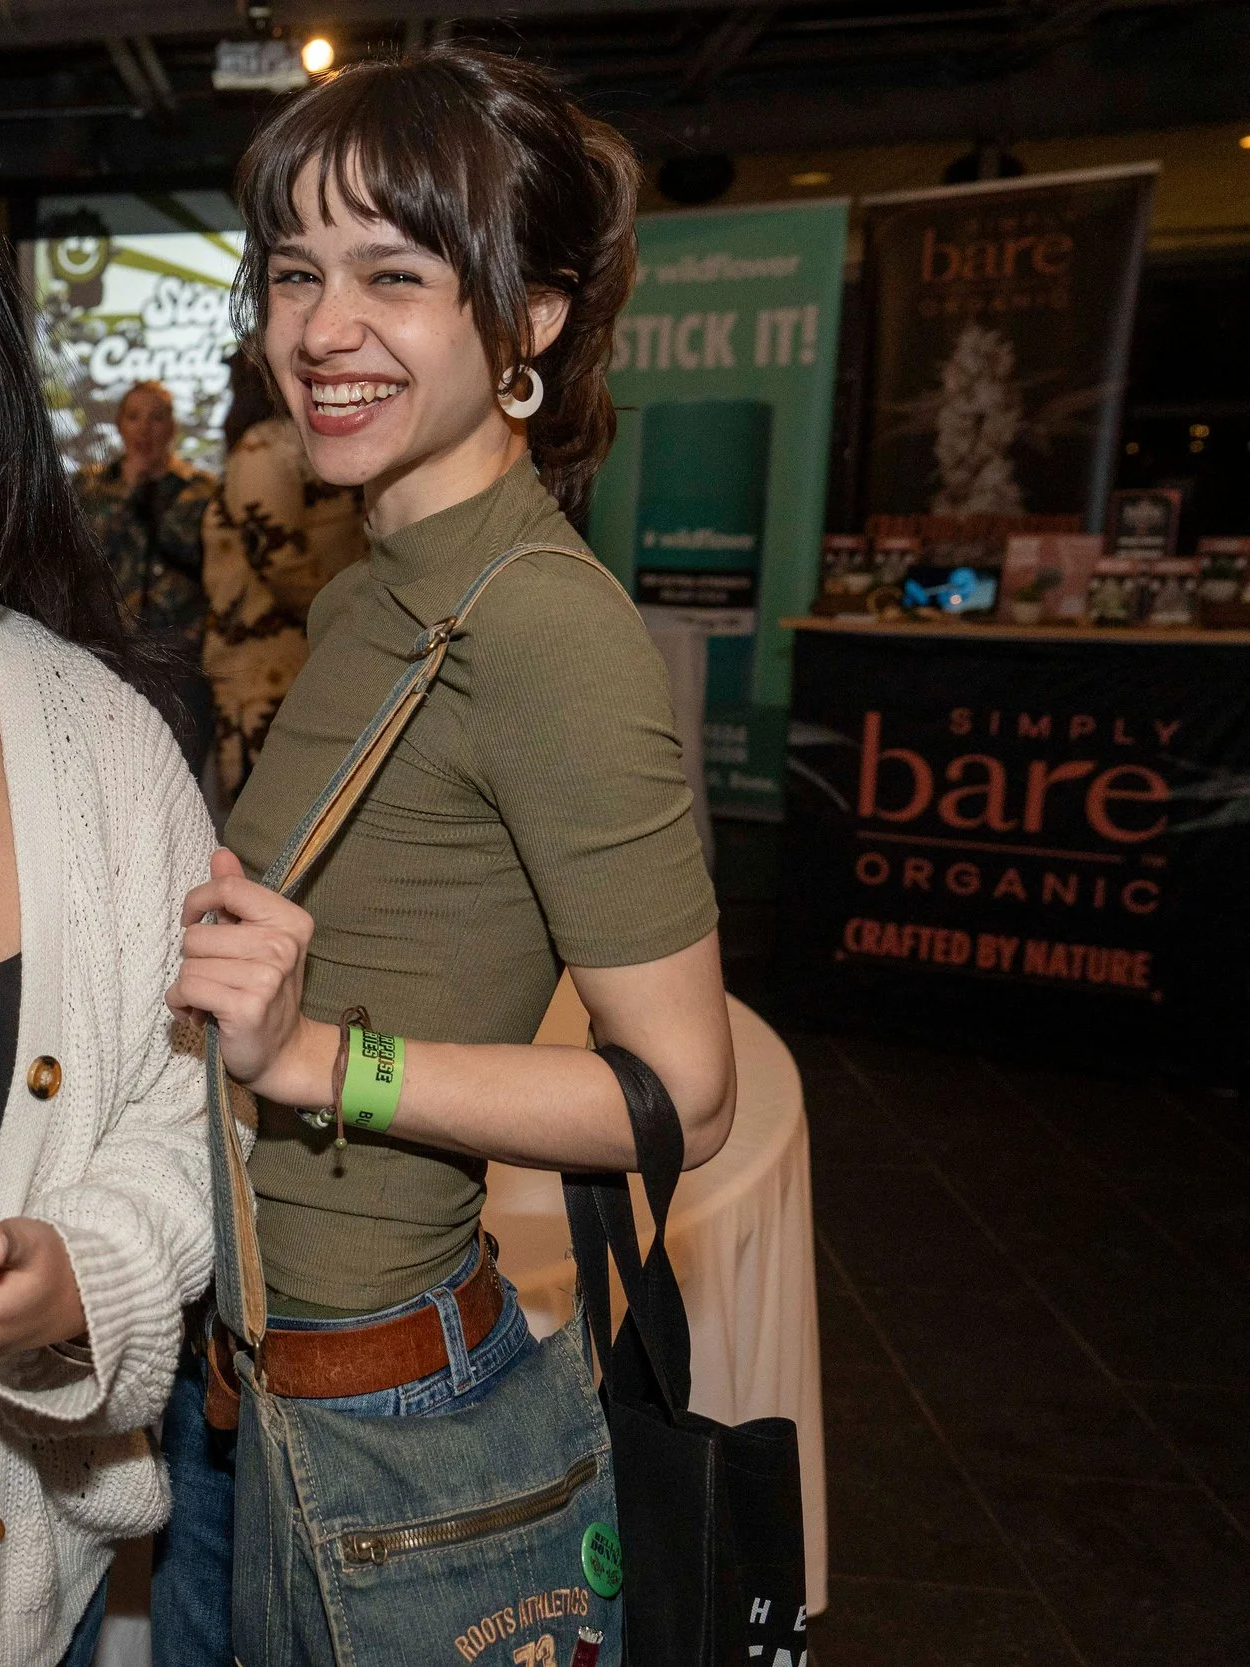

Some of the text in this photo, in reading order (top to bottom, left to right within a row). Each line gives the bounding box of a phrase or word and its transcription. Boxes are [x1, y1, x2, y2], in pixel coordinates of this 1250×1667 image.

[610, 304, 819, 371] STICK IT!
[949, 706, 1183, 748] SIMPLY
[855, 710, 1173, 845] bare
[854, 850, 1163, 916] ORGANIC
[842, 916, 973, 967] CRAFTED
[974, 931, 1022, 973] BY
[454, 1586, 590, 1663] ROOTS ATHLETICS
